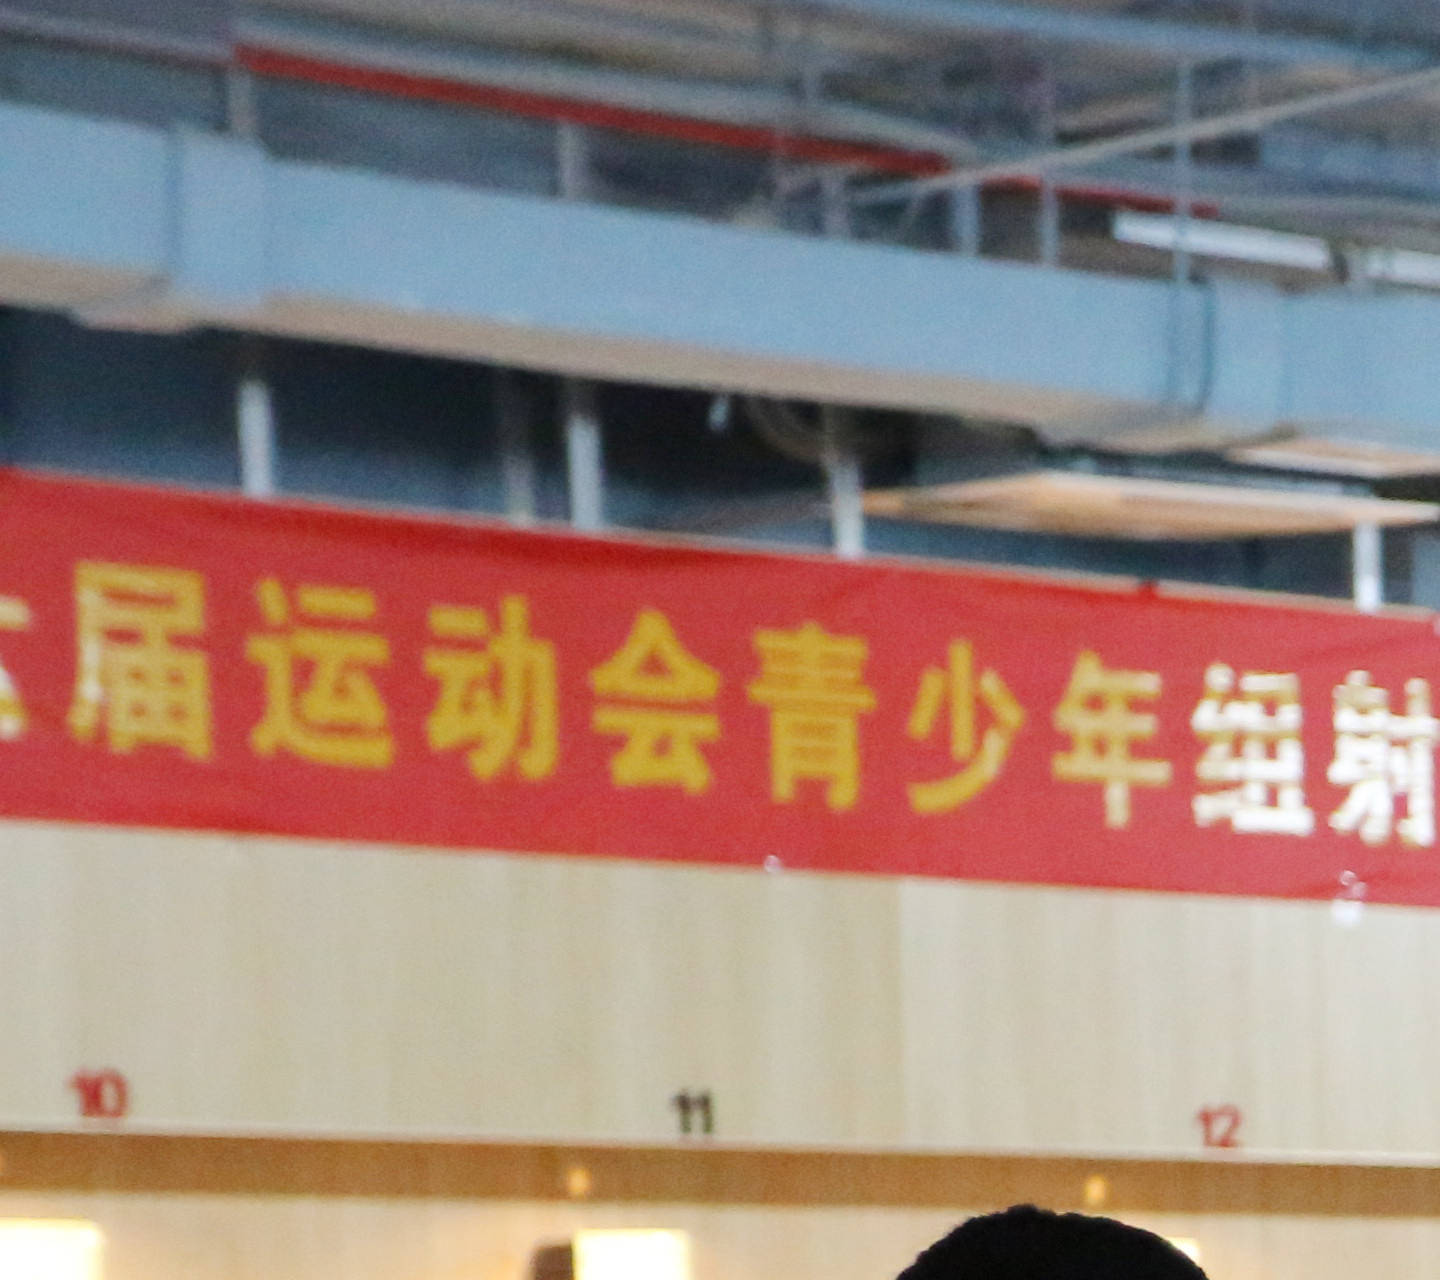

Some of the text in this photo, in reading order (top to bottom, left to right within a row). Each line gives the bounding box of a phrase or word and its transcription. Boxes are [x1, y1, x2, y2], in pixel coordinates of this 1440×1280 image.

[69, 1068, 131, 1119] 10
[670, 1088, 714, 1134] 11
[1197, 1103, 1242, 1148] 12
